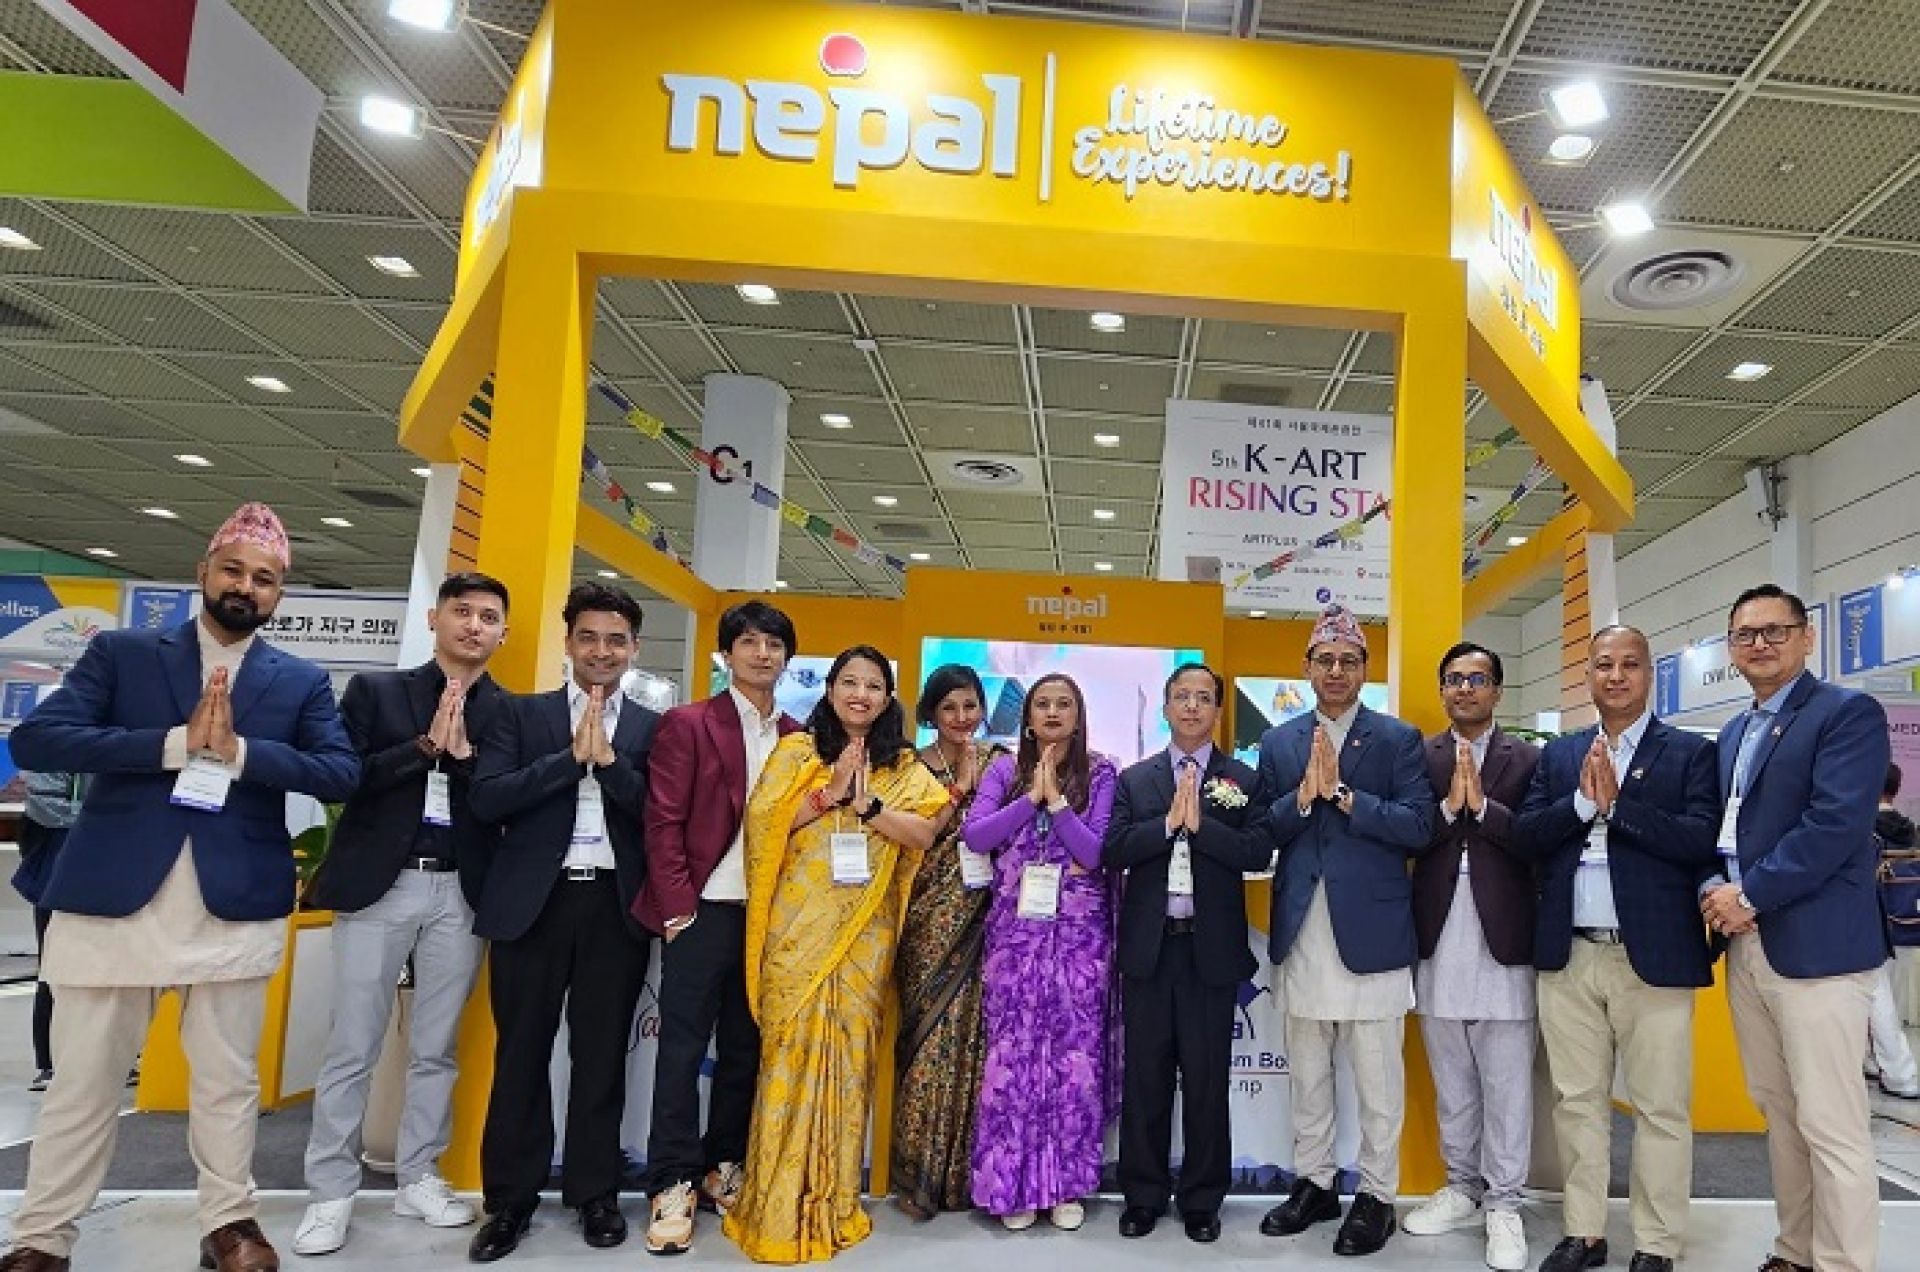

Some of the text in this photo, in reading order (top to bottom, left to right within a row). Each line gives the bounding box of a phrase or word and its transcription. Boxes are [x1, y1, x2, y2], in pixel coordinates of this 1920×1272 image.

[662, 73, 1022, 190] nepal
[1105, 83, 1288, 156] Lifetime
[1071, 126, 1353, 203] Experiences!
[1211, 443, 1367, 481] 5th K-ART
[1188, 477, 1318, 516] RISING
[320, 616, 355, 634] 지구
[1027, 594, 1108, 620] nepal
[1258, 1052, 1290, 1070] Bo
